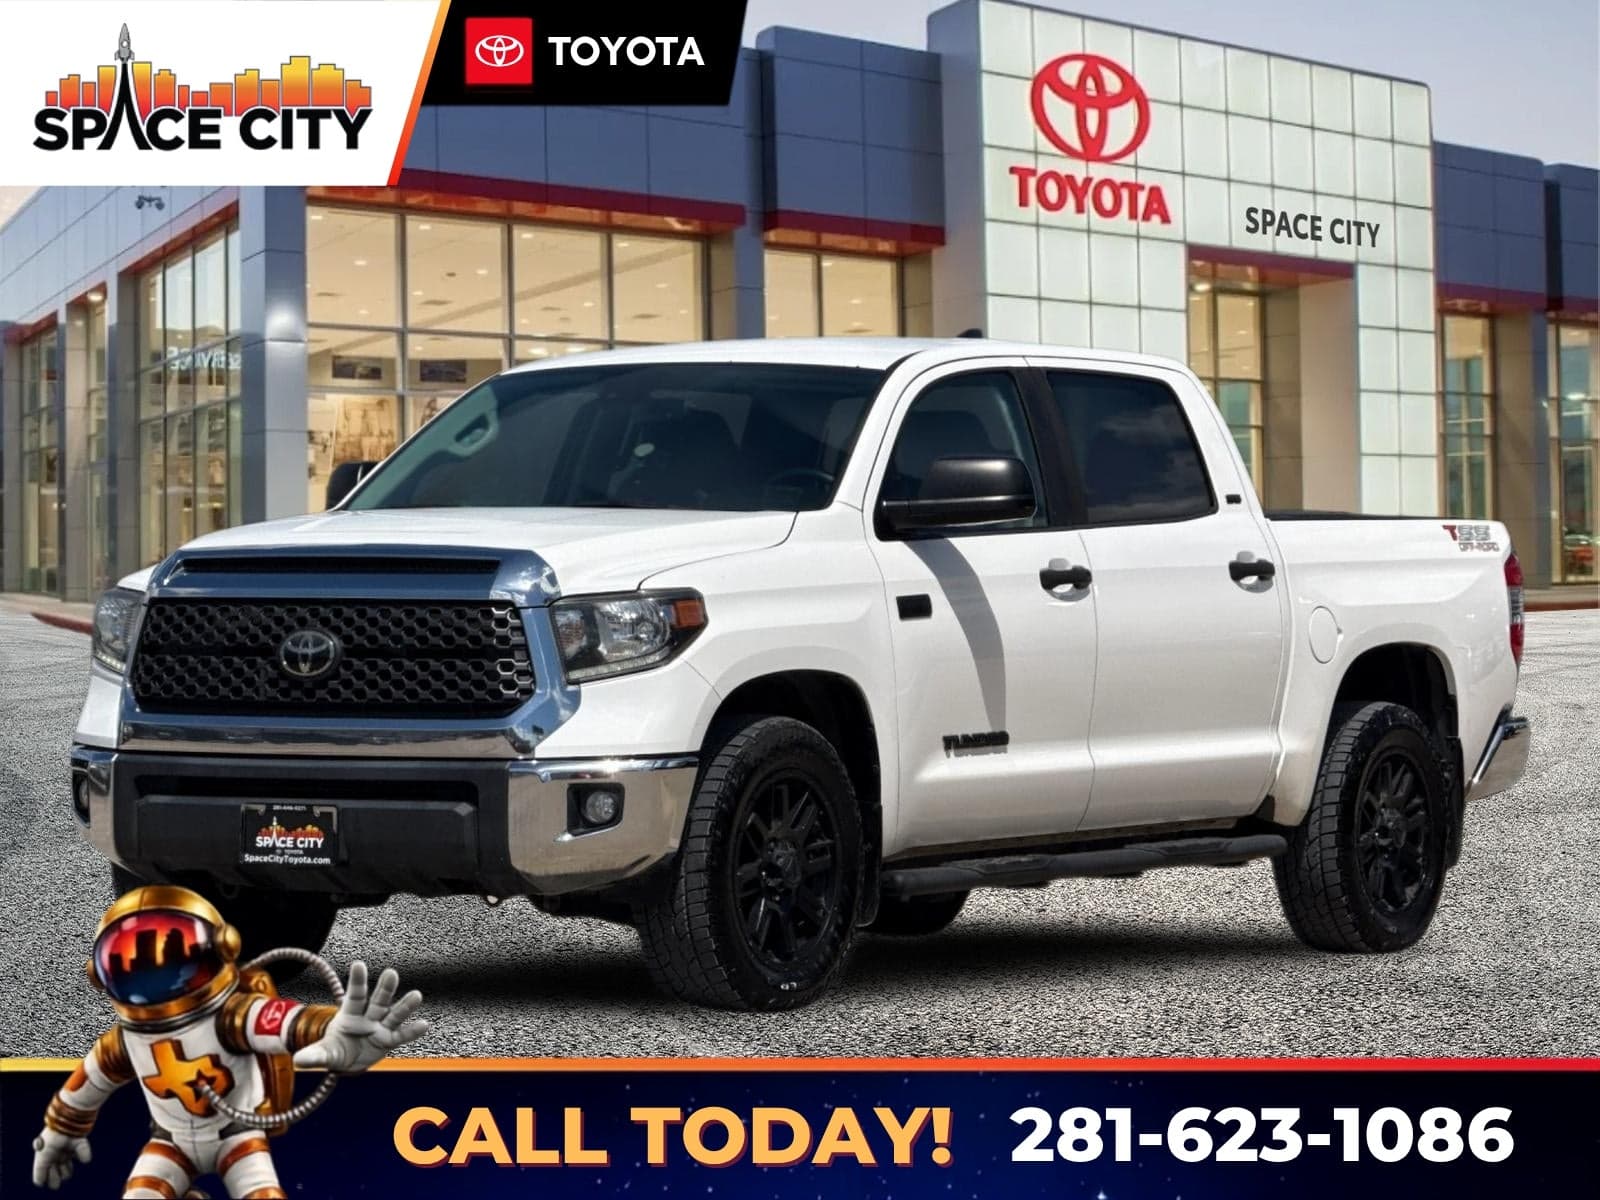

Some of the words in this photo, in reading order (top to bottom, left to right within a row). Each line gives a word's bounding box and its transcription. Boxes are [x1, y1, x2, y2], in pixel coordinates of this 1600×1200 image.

[1009, 166, 1172, 225] TOYOTA
[1245, 206, 1322, 242] SPACE
[1329, 218, 1381, 248] CITY
[256, 836, 294, 848] SPACE
[296, 837, 324, 848] CITY
[245, 854, 331, 864] SpaceCityToyota.com
